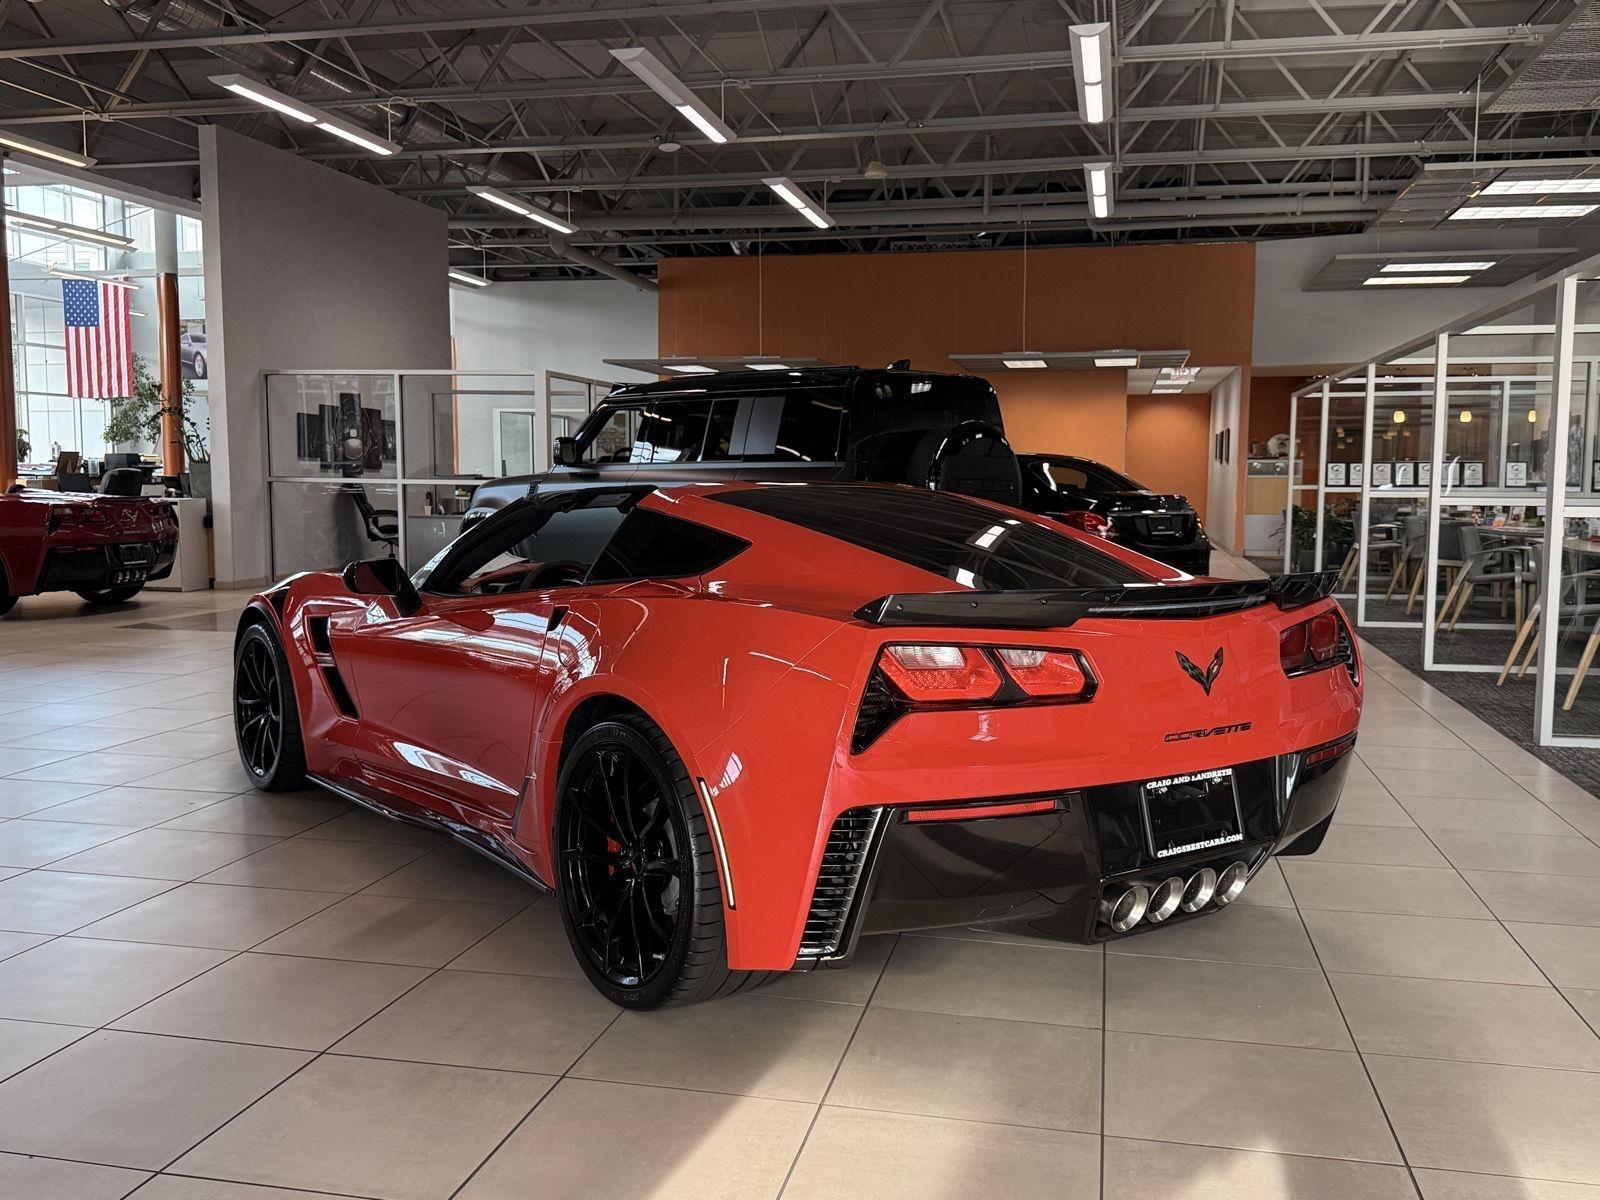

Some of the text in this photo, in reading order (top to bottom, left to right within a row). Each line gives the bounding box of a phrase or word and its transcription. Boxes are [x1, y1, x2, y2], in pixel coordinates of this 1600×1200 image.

[1164, 722, 1251, 742] CORVETTE
[1146, 768, 1232, 789] CRAIG AND LANDRETH
[1157, 833, 1243, 858] CRAIGSBESTCARS.COM
